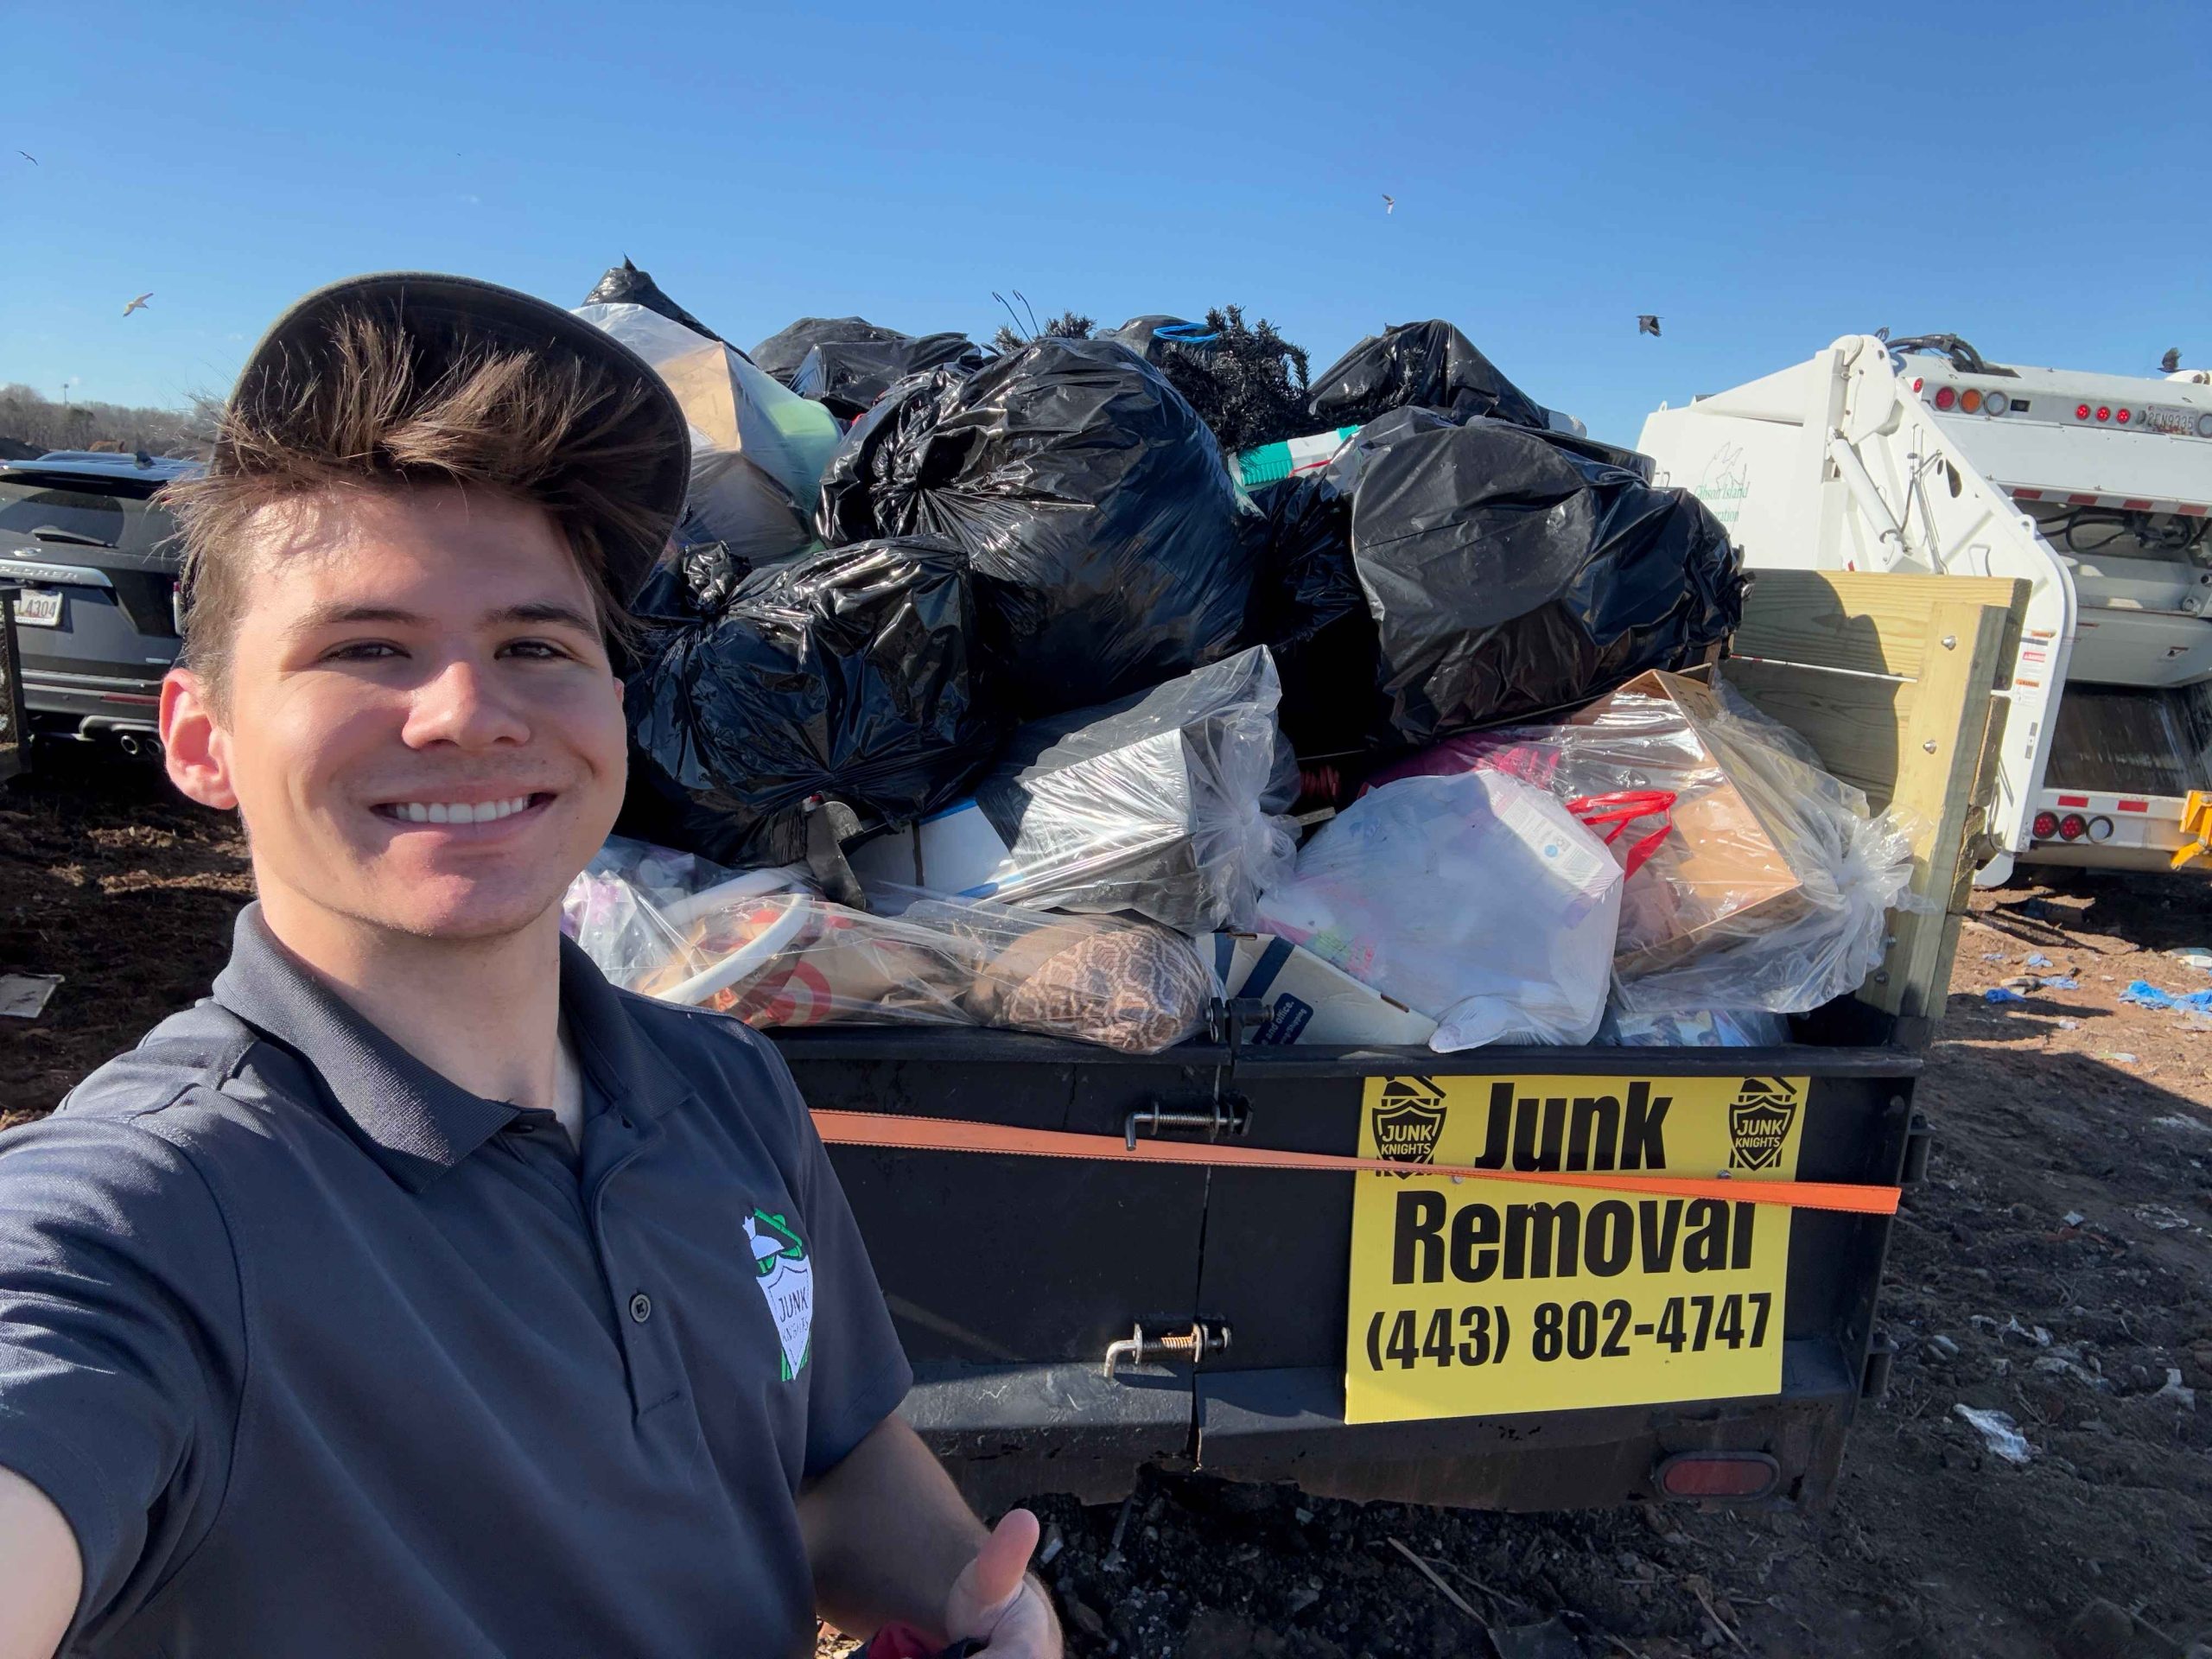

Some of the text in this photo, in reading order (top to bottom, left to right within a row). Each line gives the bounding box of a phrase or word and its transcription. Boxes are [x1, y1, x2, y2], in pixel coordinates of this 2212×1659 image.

[1722, 482, 1750, 499] Island
[1382, 1123, 1433, 1143] JUNK
[1474, 1081, 1673, 1172] Junk
[1736, 1118, 1783, 1137] JUNK
[1381, 1141, 1432, 1157] KNIGHTS
[1735, 1135, 1782, 1149] KNIGHTS
[1392, 1190, 1757, 1285] Removal
[779, 1287, 809, 1322] JUNK
[1366, 1292, 1772, 1372] (443) 802-4747
